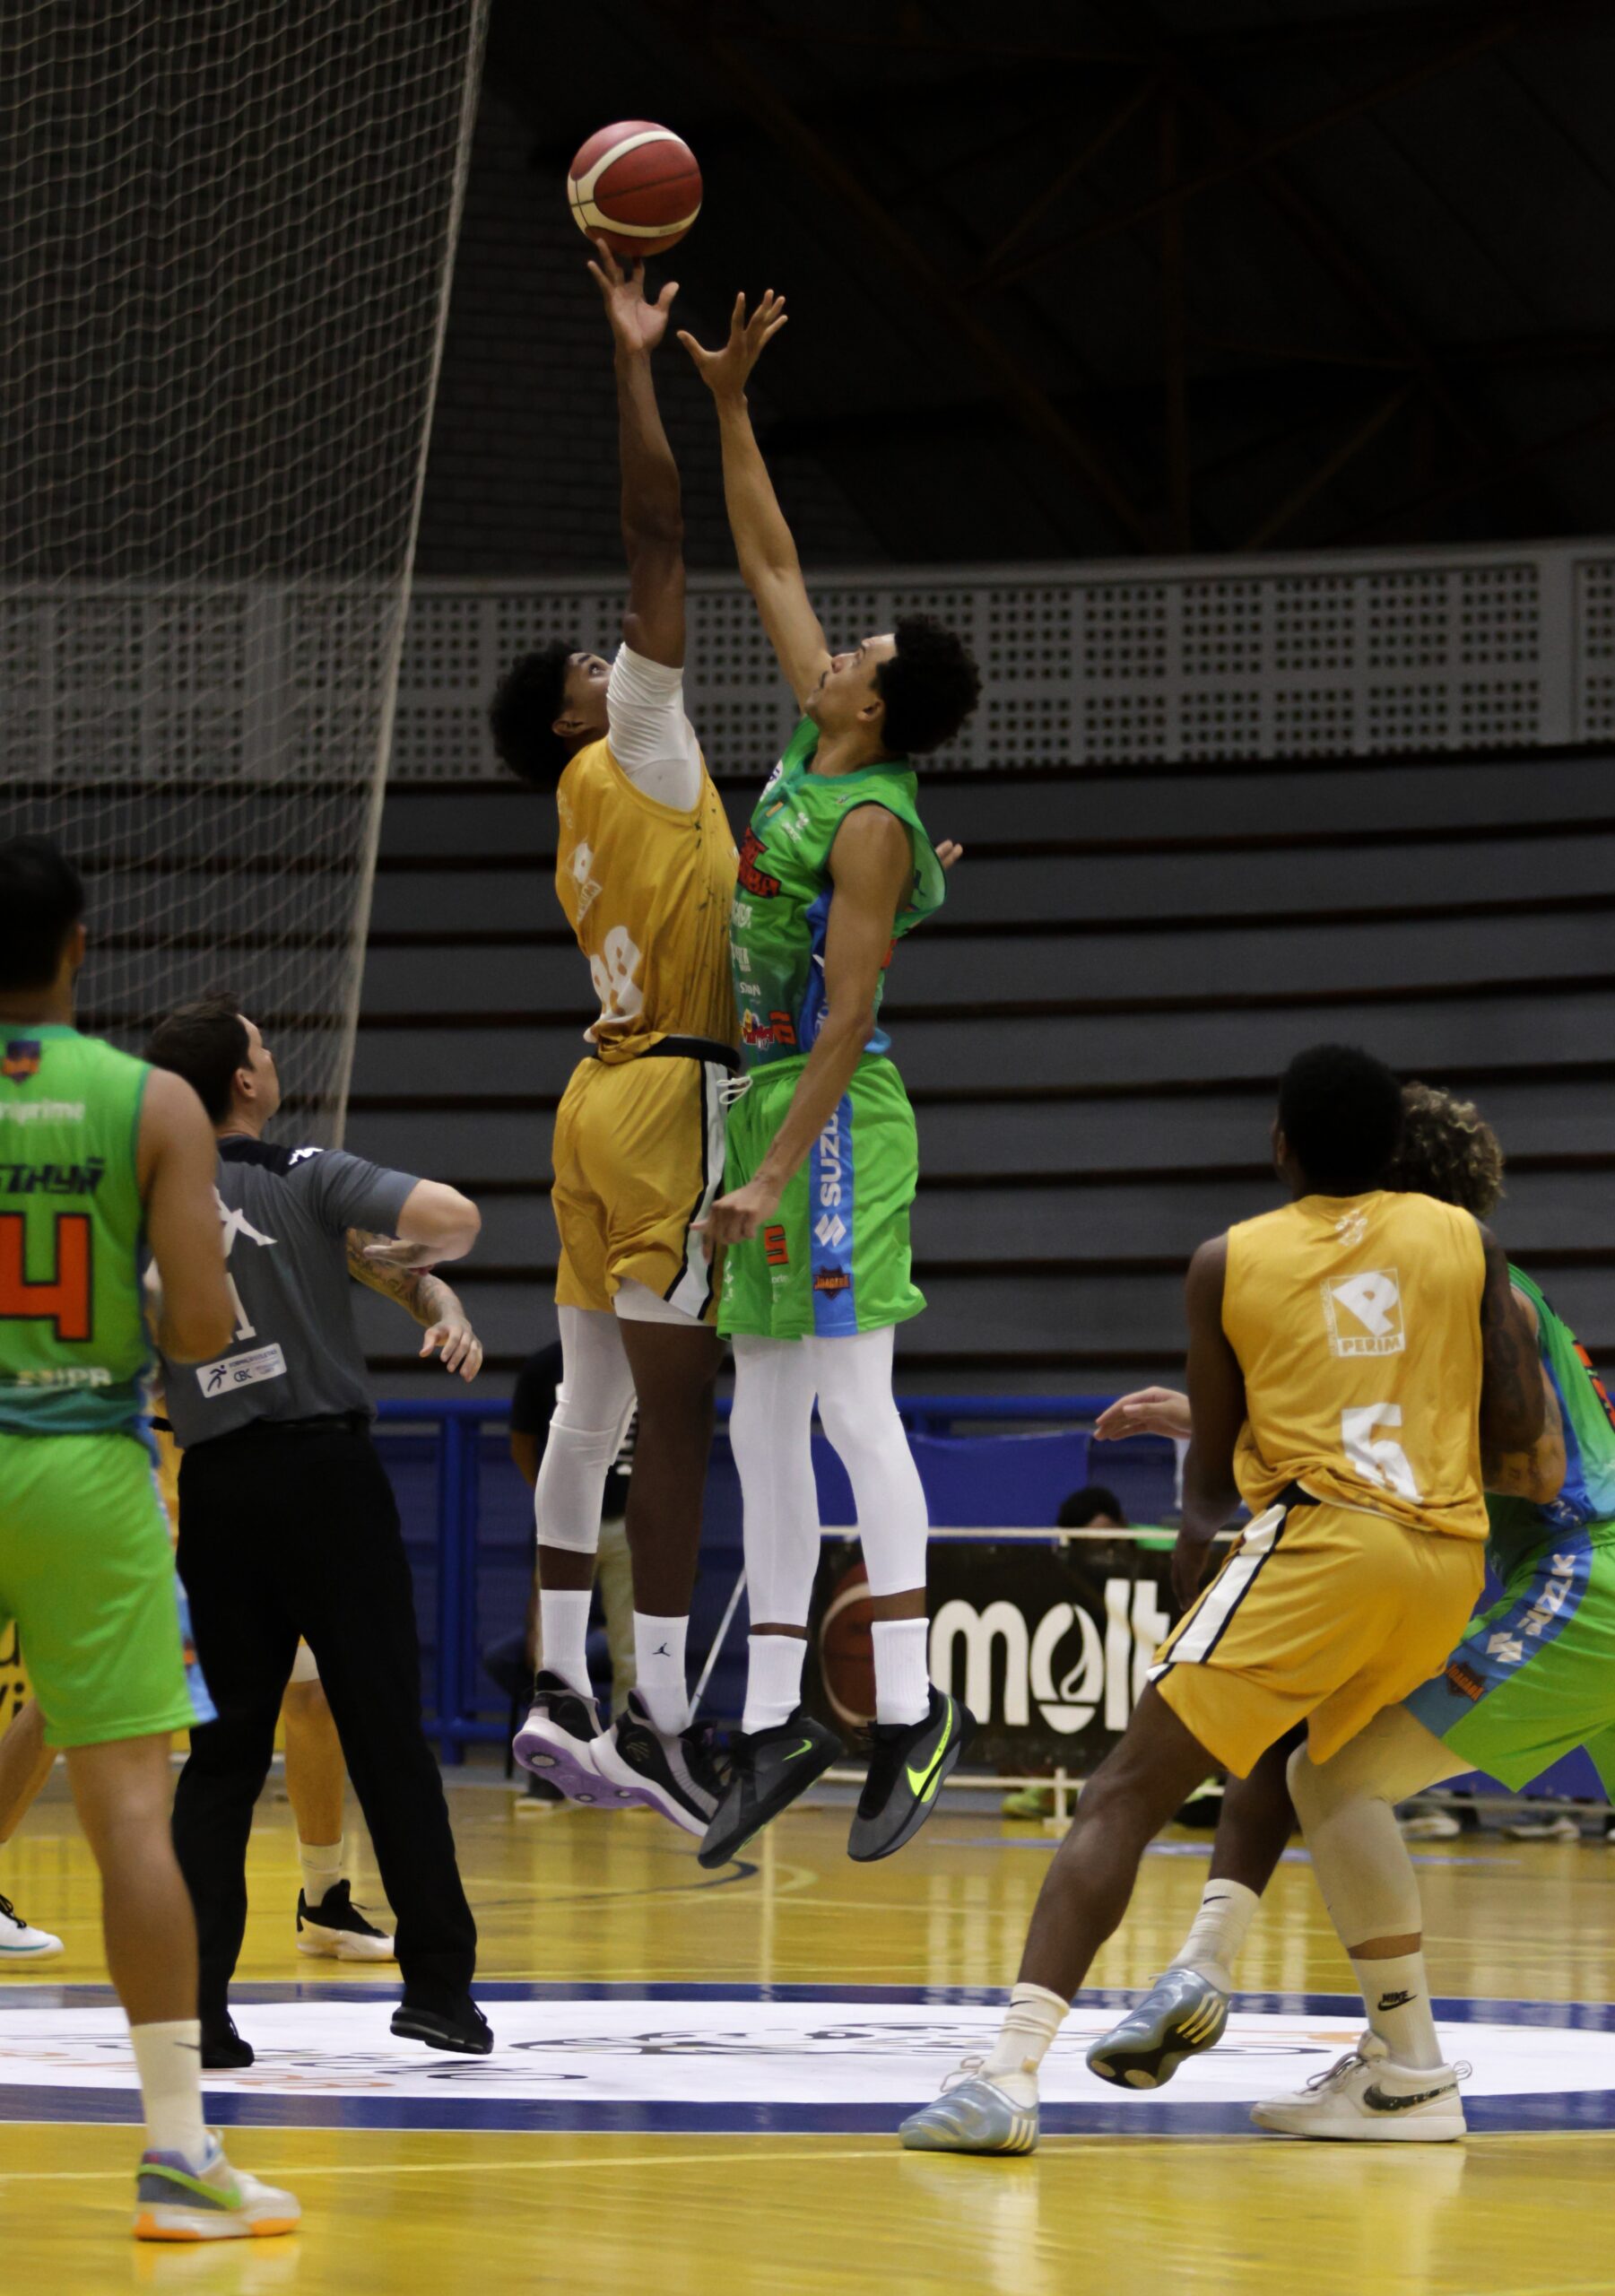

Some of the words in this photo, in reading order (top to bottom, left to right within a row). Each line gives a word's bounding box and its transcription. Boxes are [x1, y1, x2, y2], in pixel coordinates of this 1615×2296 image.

[820, 1105, 841, 1207] SUZU
[1340, 1335, 1402, 1355] PERIM
[930, 1578, 1170, 1735] molt
[1382, 1990, 1409, 2003] NIKE
